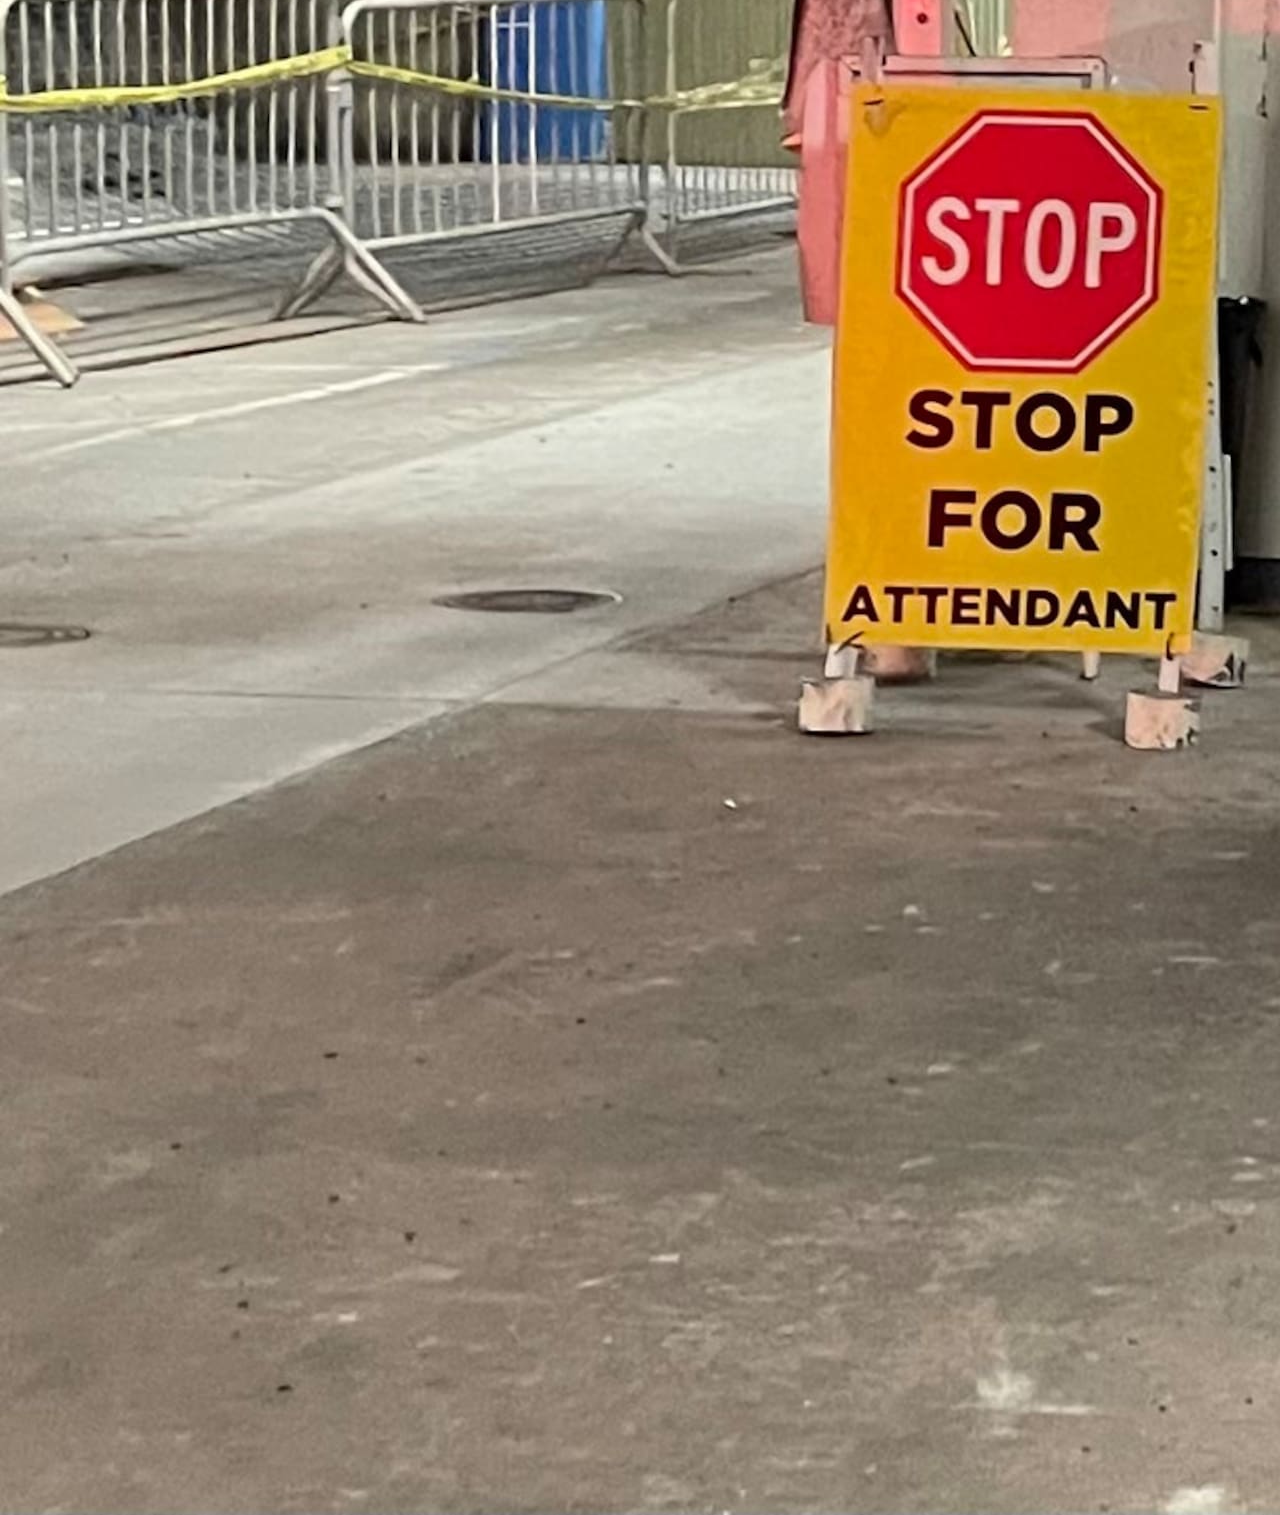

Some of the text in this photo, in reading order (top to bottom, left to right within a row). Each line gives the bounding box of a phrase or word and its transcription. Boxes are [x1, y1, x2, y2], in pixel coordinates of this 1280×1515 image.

[920, 195, 1138, 290] STOP
[904, 388, 1135, 453] STOP
[926, 488, 1103, 552] FOR
[840, 584, 1178, 631] ATTENDANT
